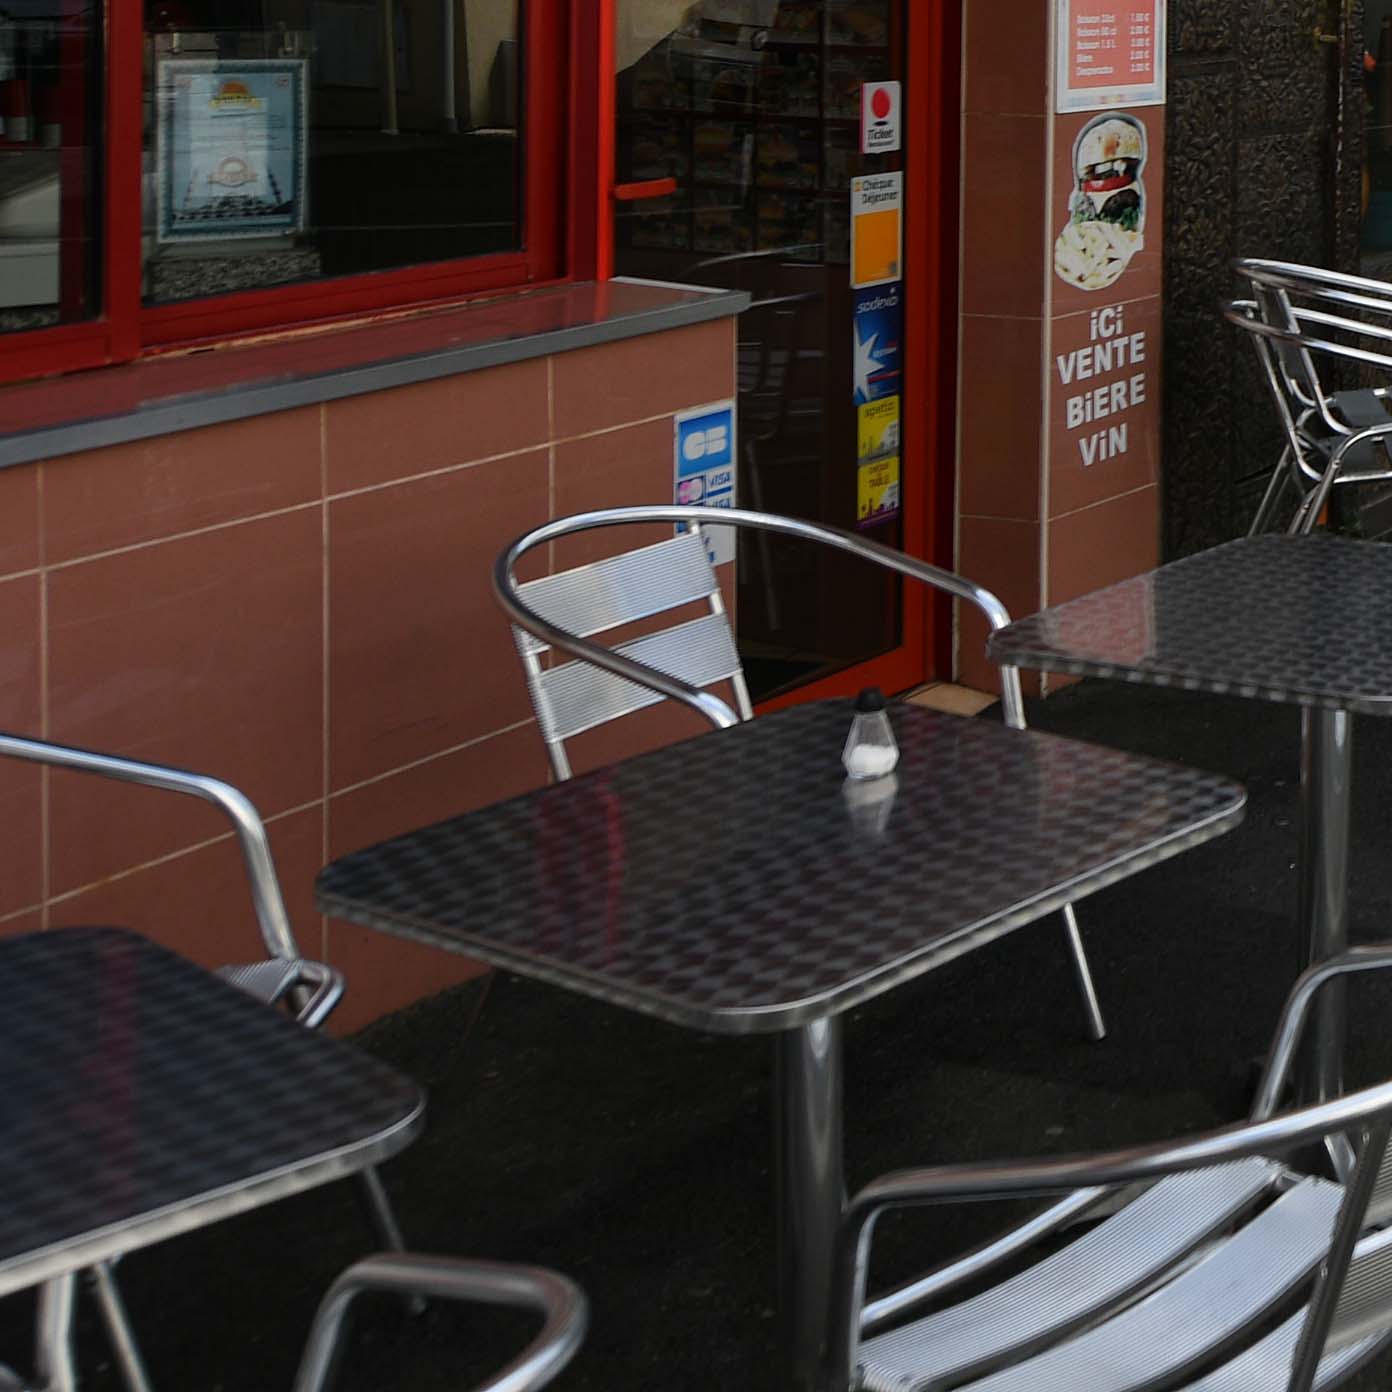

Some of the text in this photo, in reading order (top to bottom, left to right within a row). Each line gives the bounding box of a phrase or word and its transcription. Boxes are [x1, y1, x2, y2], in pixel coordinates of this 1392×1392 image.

[1090, 304, 1124, 341] iCi
[1056, 331, 1146, 385] VENTE
[1066, 372, 1147, 430] BiERE
[1078, 422, 1128, 467] ViN
